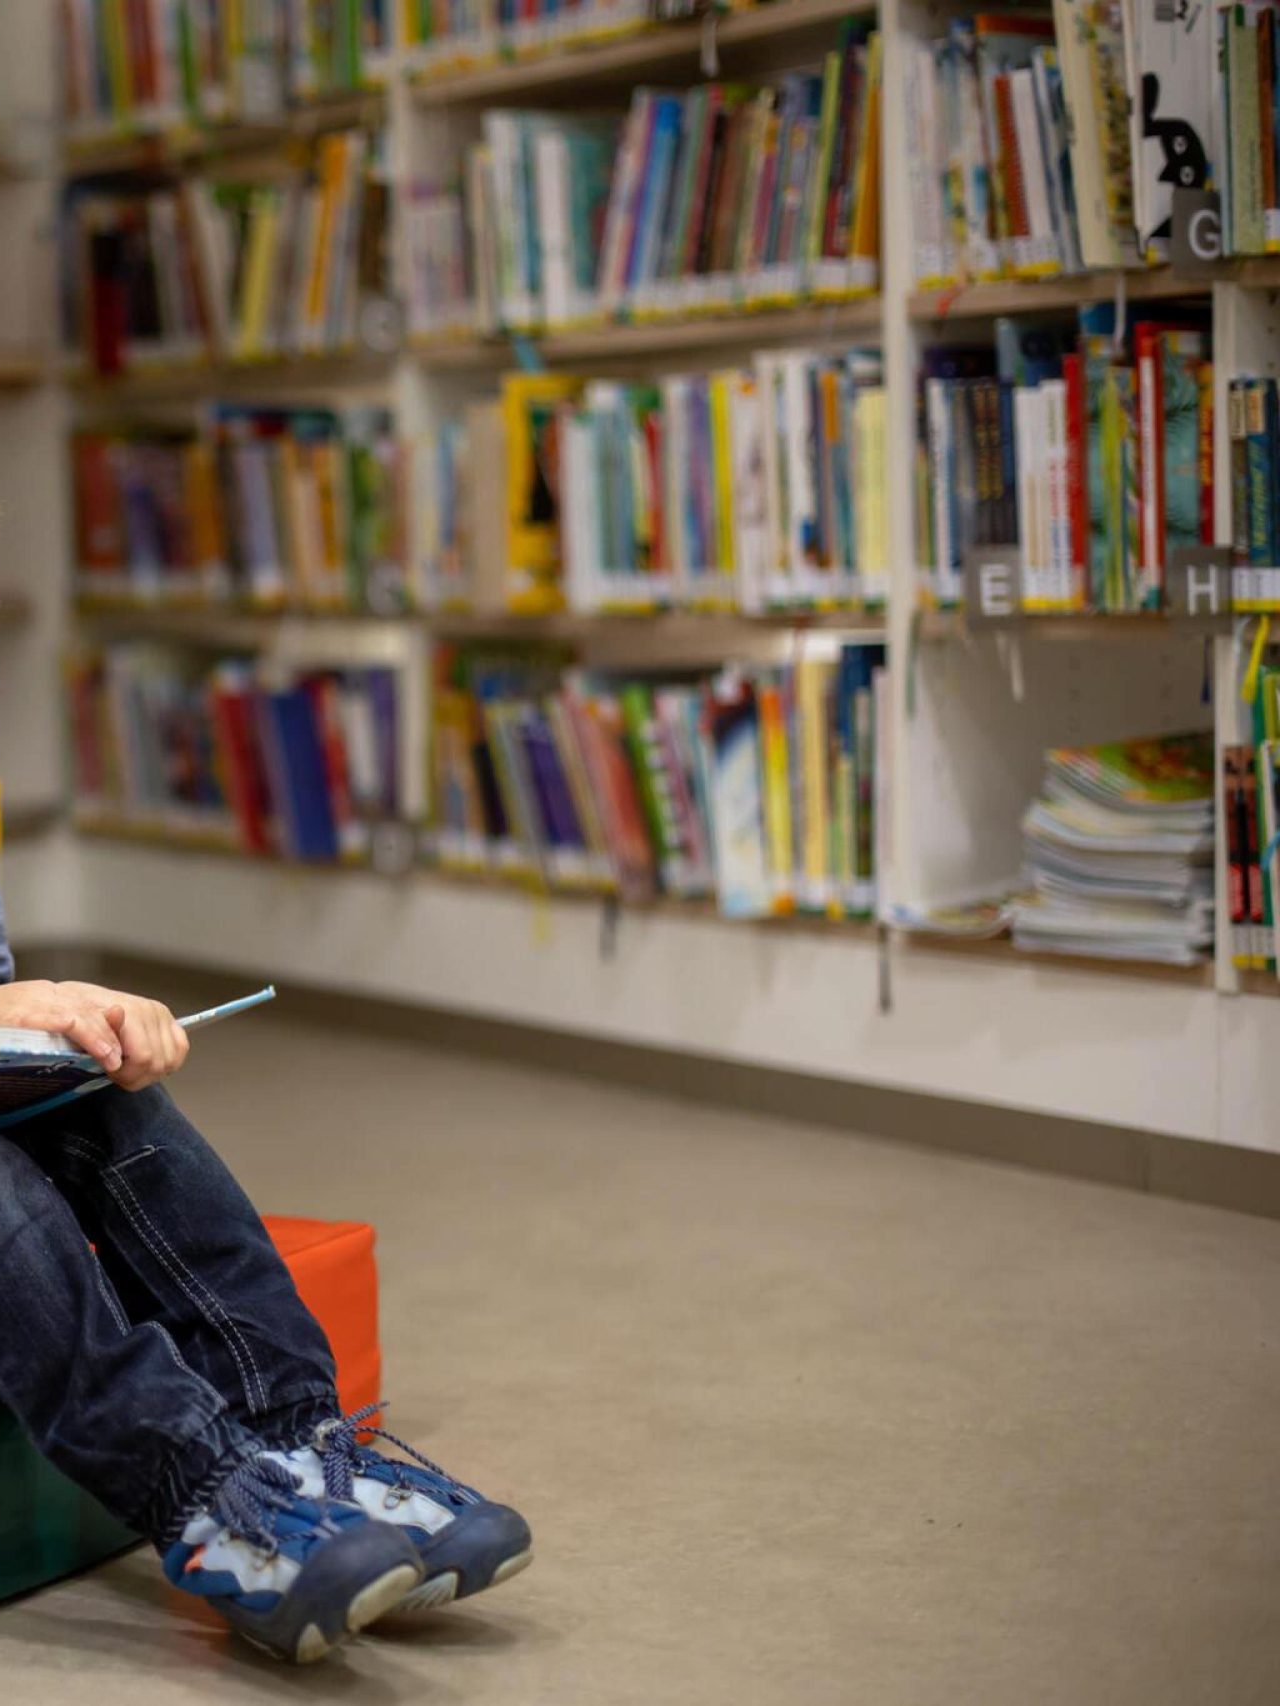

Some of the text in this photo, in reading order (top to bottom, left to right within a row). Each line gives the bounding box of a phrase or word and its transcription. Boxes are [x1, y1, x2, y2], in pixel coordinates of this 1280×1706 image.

[1187, 208, 1221, 260] G
[980, 563, 1013, 616] E
[1186, 564, 1220, 616] H
